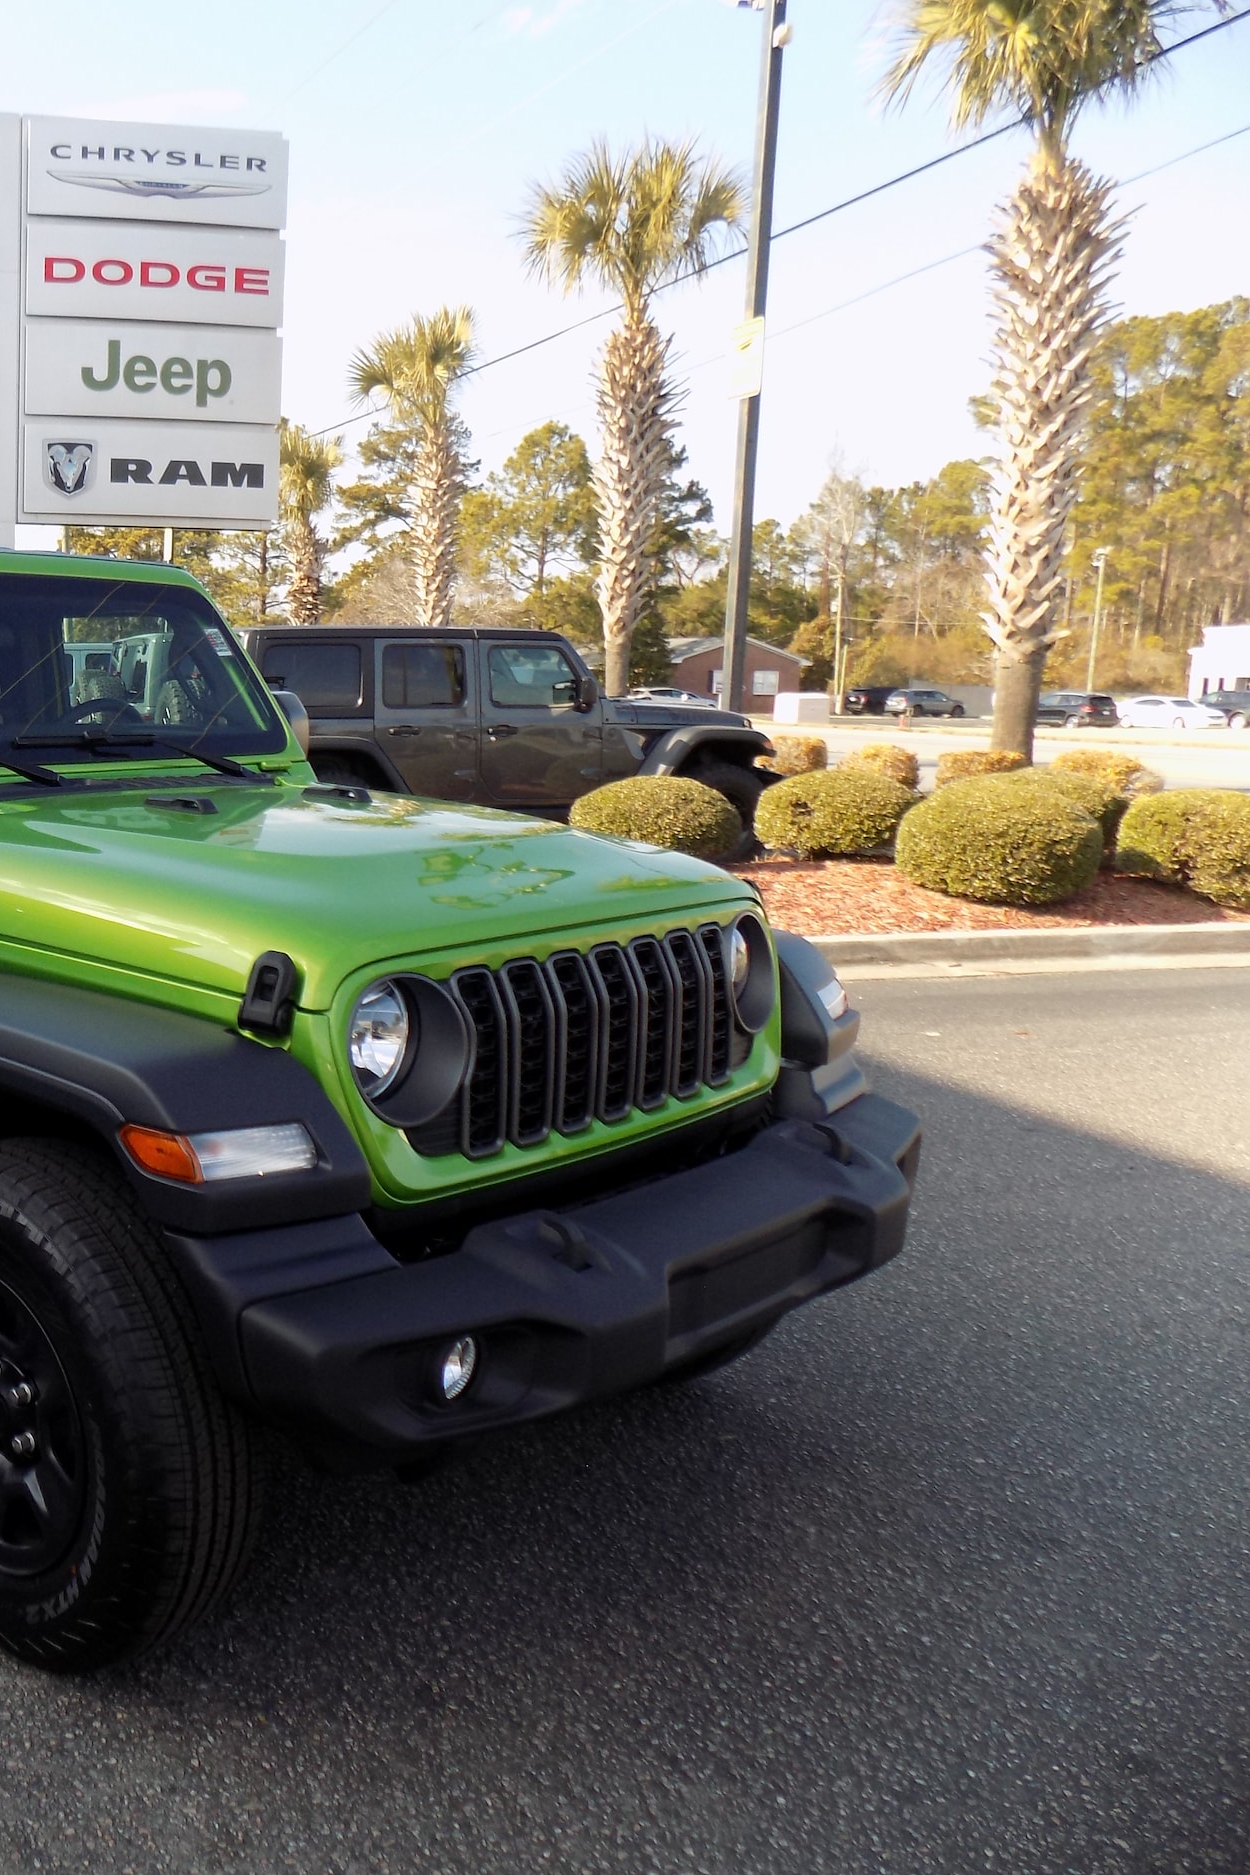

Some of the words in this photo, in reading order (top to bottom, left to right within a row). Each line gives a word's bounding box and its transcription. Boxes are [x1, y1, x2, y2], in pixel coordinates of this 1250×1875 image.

[51, 145, 267, 172] CHRYSLER
[44, 257, 269, 295] DODGE
[81, 340, 231, 407] Jeep
[110, 458, 264, 489] RAM
